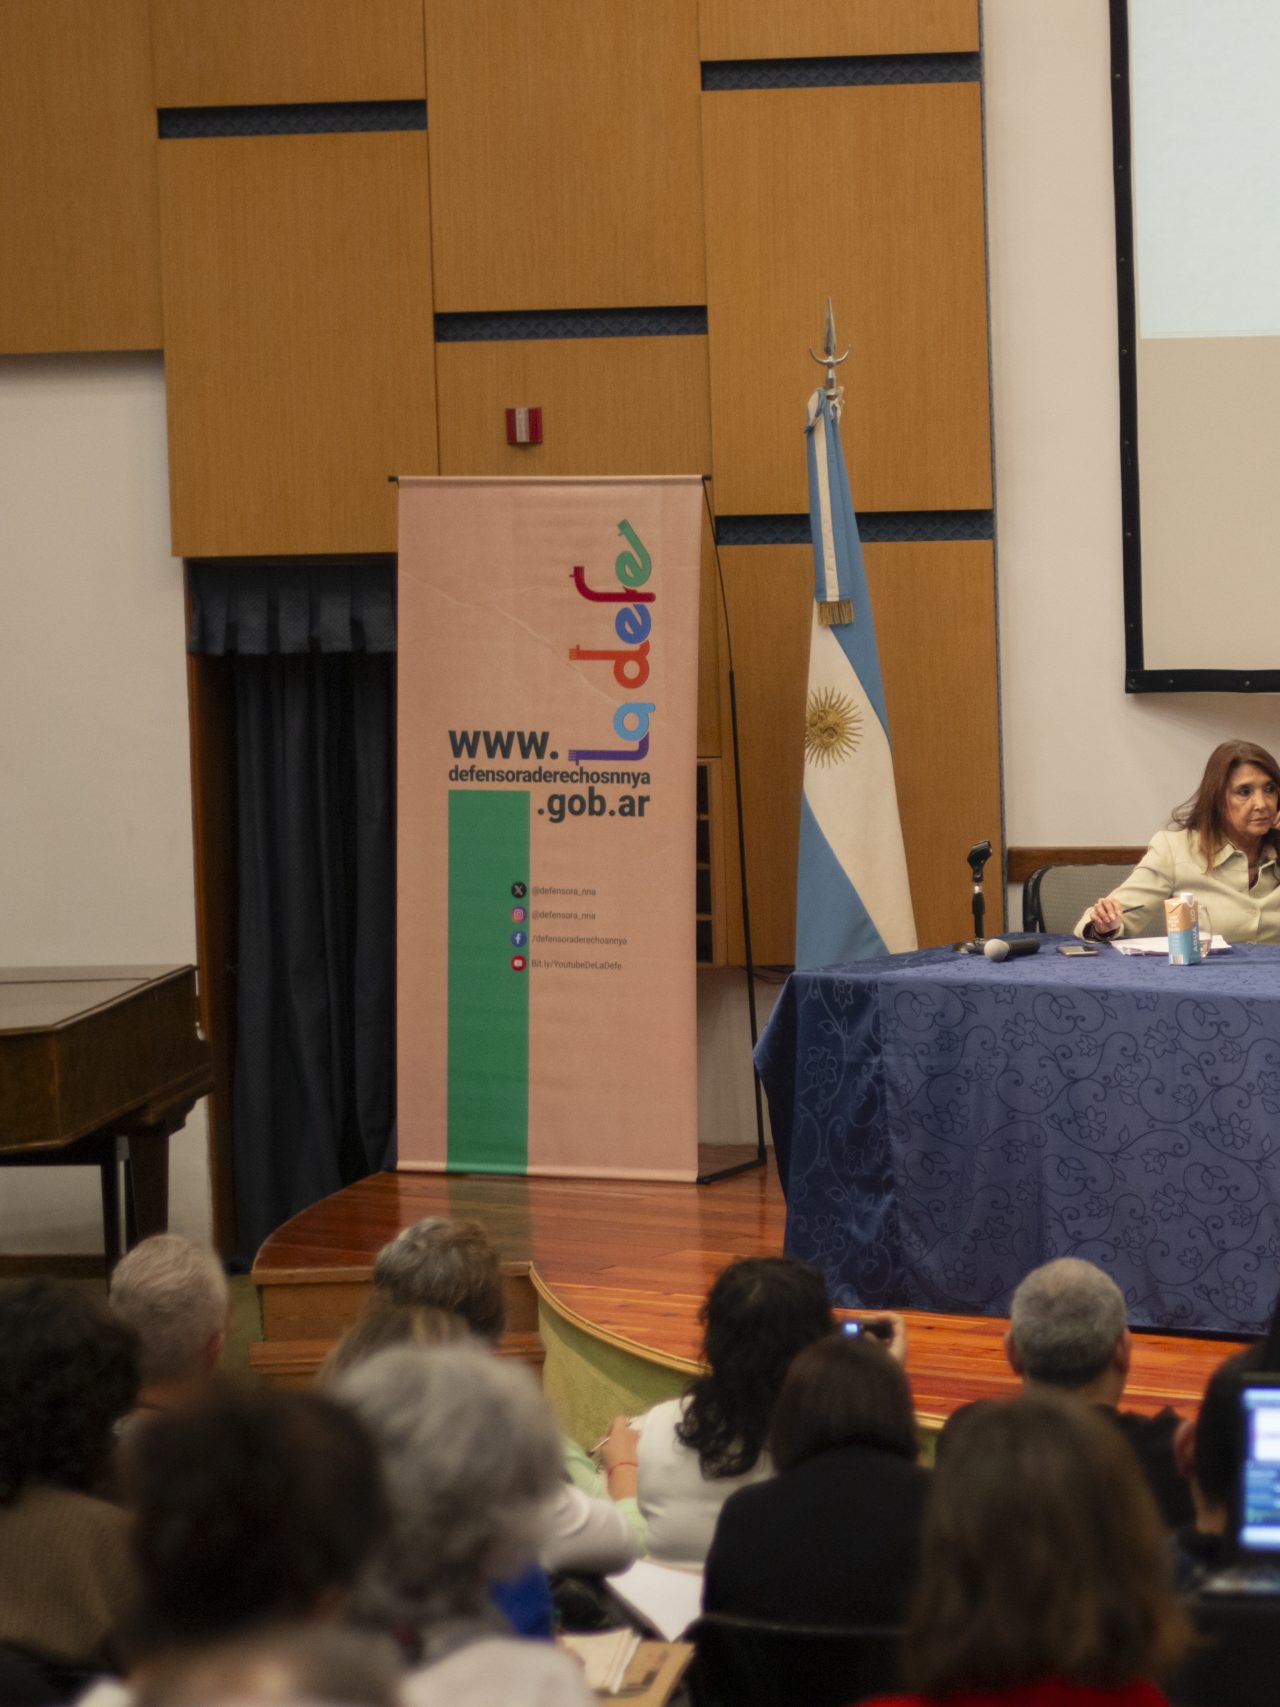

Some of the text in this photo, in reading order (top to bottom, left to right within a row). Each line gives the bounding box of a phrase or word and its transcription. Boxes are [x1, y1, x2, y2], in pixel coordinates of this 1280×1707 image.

[448, 730, 559, 760] www.
[448, 766, 651, 788] defensoraderechosnnya
[537, 786, 651, 823] .gob.ar
[531, 885, 597, 897] @defensora_nna
[531, 910, 596, 921] @defensora_nna
